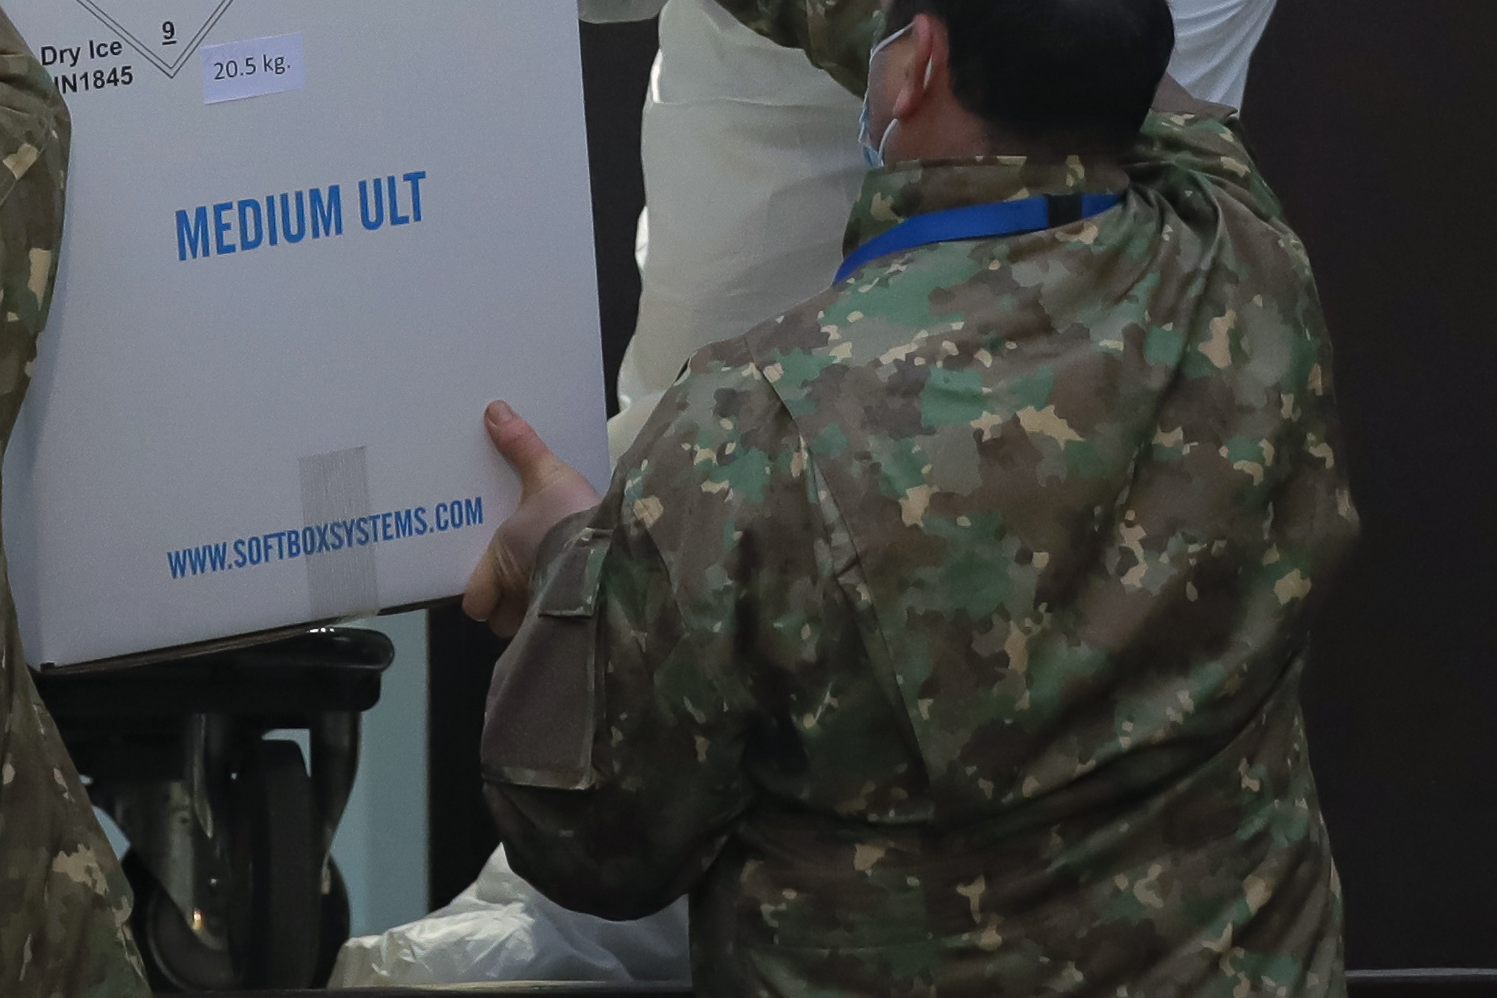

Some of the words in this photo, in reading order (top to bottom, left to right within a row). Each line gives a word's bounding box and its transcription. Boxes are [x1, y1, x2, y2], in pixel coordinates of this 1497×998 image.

[162, 21, 176, 41] 9
[41, 45, 81, 67] Dry
[89, 40, 123, 60] Ice
[213, 57, 256, 81] 20.5
[263, 54, 291, 76] kg.
[175, 184, 343, 261] MEDIUM
[358, 170, 426, 230] ULT
[167, 497, 484, 580] WWW.SOFTBOXSYSTEMS.COM
